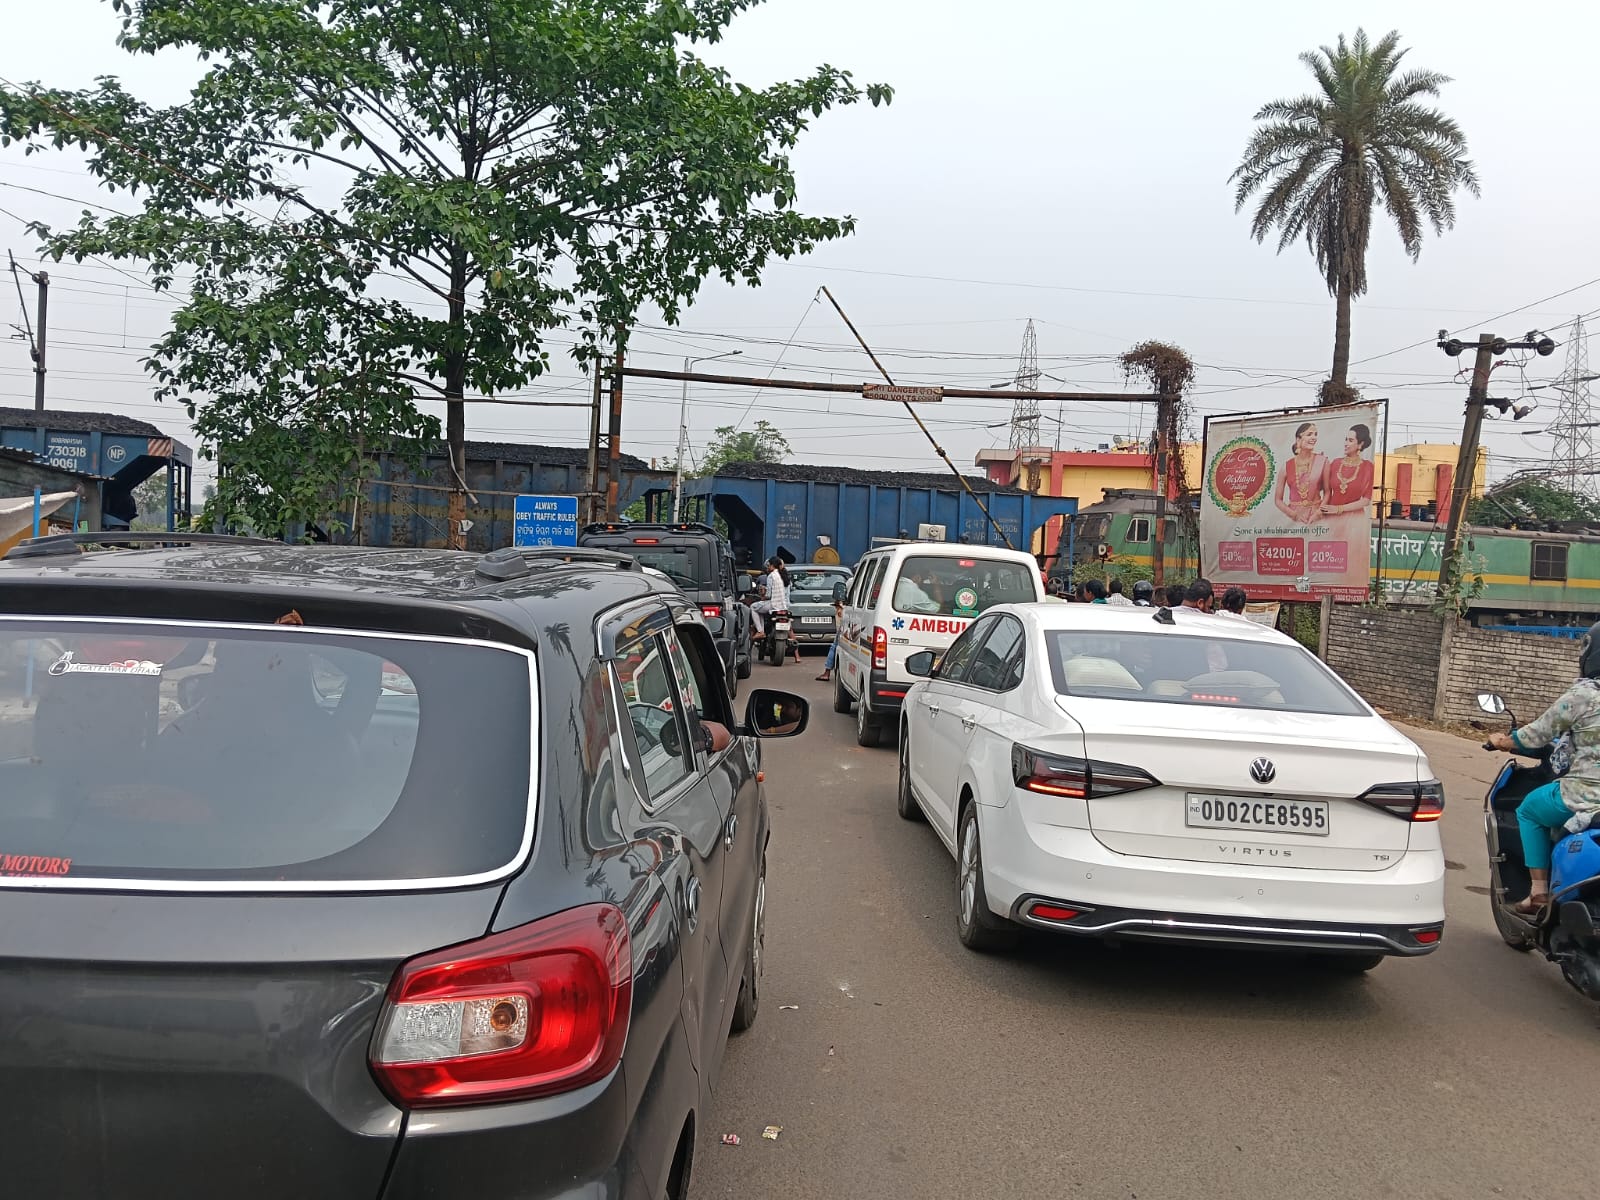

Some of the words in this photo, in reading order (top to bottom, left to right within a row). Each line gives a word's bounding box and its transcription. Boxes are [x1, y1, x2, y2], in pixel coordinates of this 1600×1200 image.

[887, 386, 918, 394] DANGER
[48, 445, 86, 457] 730318
[109, 449, 124, 459] NP
[534, 502, 558, 510] ALWAYS
[516, 512, 531, 520] OBEY
[533, 512, 556, 521] TRAFFIC
[557, 513, 576, 521] RULES
[1233, 527, 1251, 537] Sone
[1264, 526, 1310, 535] shubharambh
[1311, 525, 1330, 536] offer
[1222, 551, 1241, 562] 50%
[1259, 546, 1301, 559] ₹4200/-
[1311, 551, 1334, 563] 20%
[1201, 799, 1326, 829] OD02CE8595
[1218, 845, 1293, 857] VIRTUS
[0, 854, 72, 875] MOTORS
